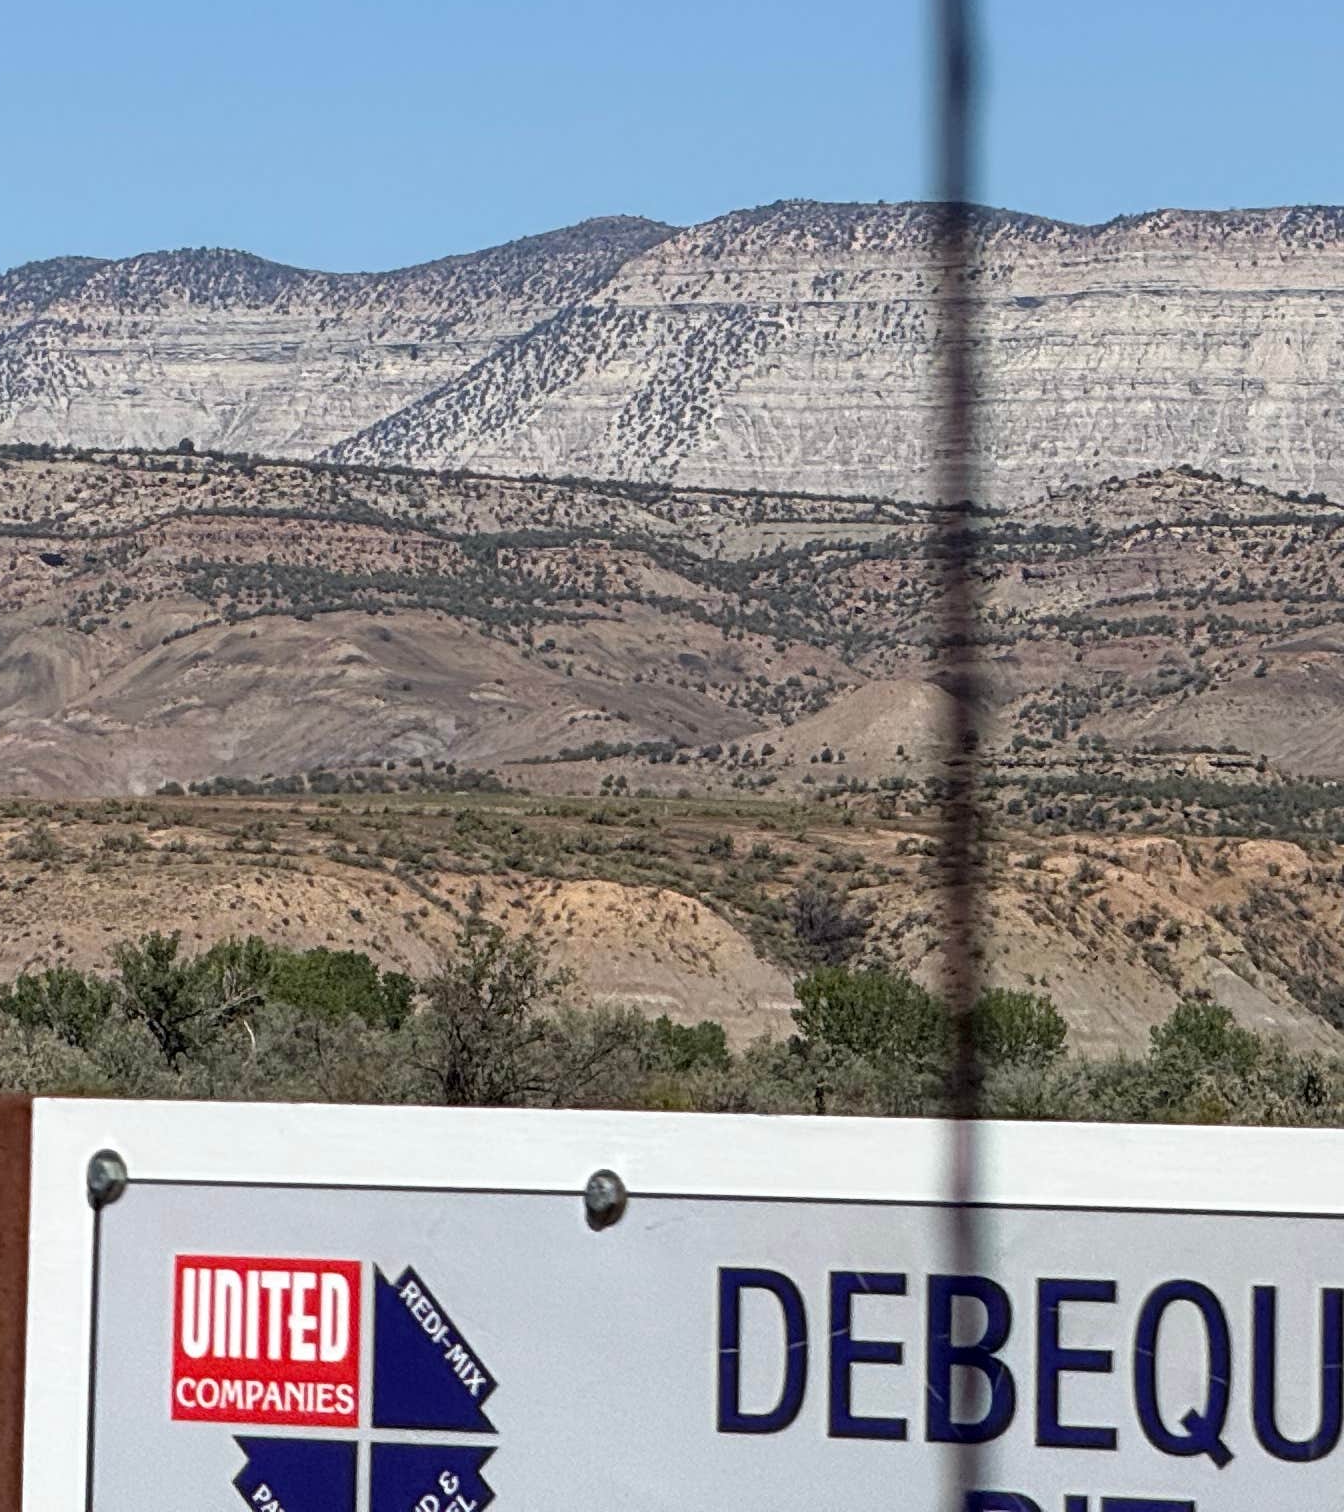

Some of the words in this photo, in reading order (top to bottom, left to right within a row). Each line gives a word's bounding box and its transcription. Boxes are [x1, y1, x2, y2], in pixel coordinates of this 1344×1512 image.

[181, 1267, 350, 1363] UNITED
[399, 1279, 488, 1397] REDI-MIX
[175, 1376, 355, 1416] COMPANIES
